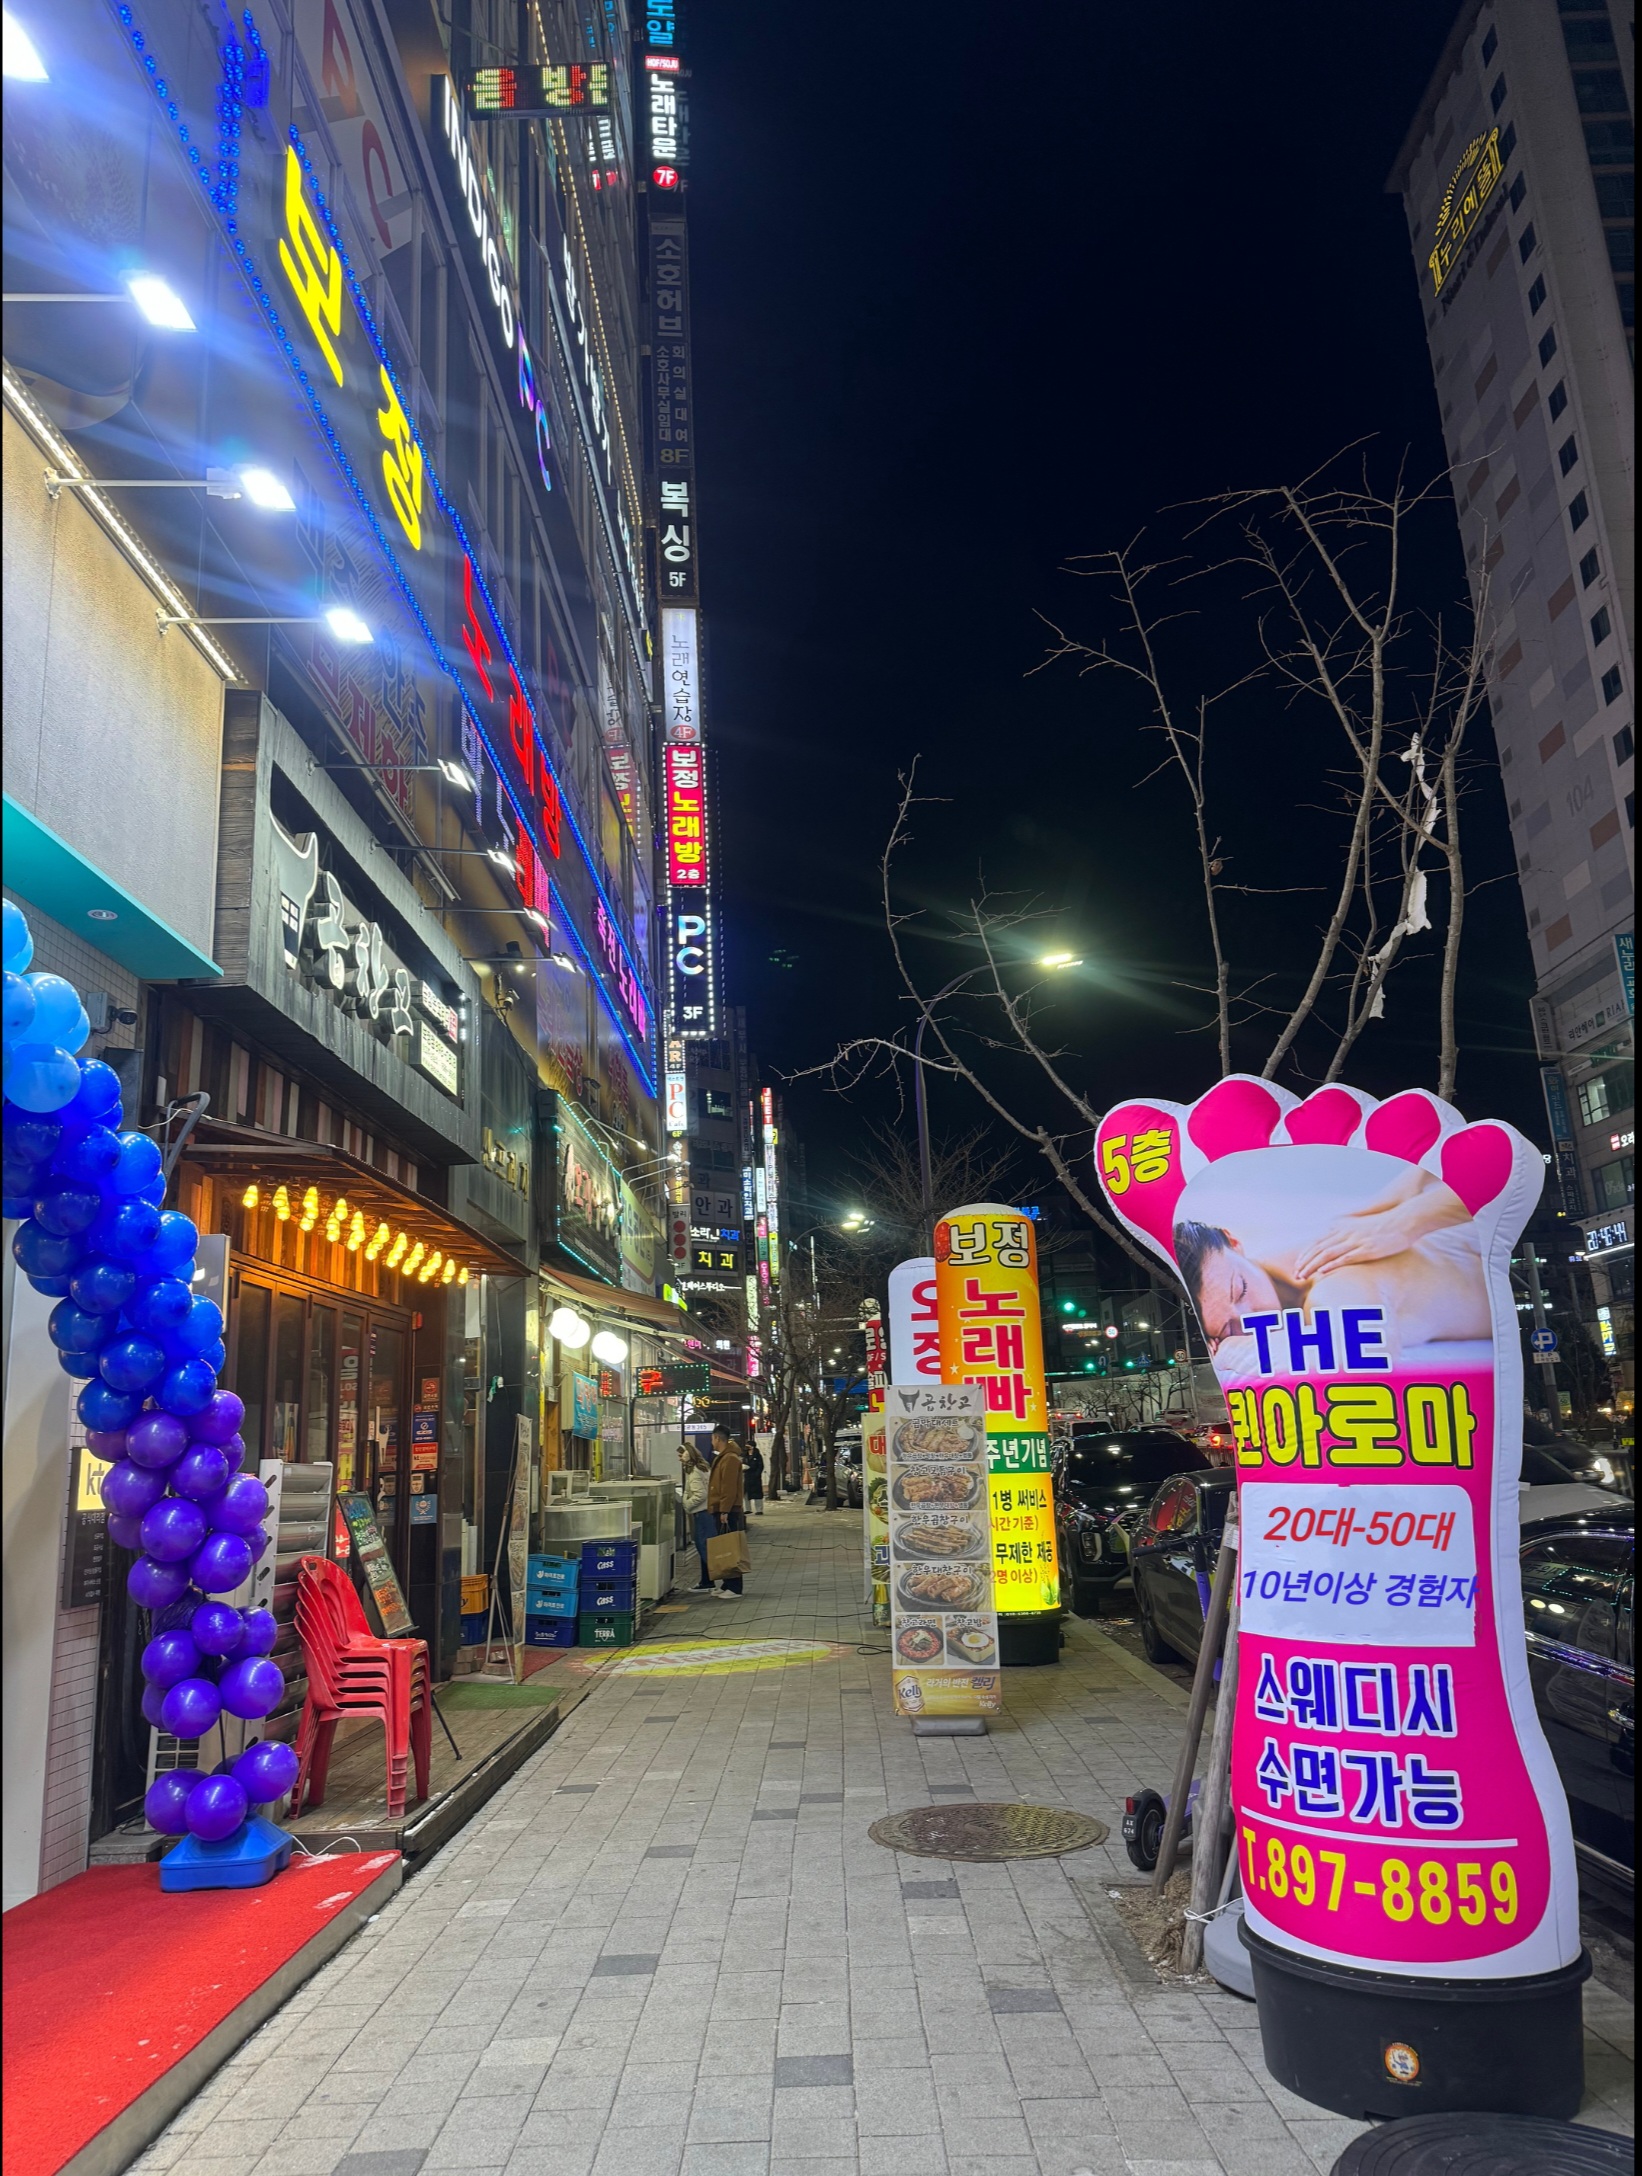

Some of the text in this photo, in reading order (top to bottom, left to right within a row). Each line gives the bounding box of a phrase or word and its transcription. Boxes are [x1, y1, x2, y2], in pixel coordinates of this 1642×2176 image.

[650, 73, 677, 159] 노래타운
[656, 170, 676, 184] 7F
[443, 73, 514, 349] INDIGO
[656, 238, 683, 337] 소호허브
[279, 145, 425, 550] 보정
[660, 449, 689, 463] 8F
[660, 481, 690, 562] 복싱
[668, 572, 687, 587] 5F
[671, 634, 692, 723] 노래연습장
[674, 727, 692, 738] 4F
[672, 749, 703, 865] 보정 노래방
[1566, 774, 1594, 818] 104
[676, 868, 700, 880] 2층
[676, 915, 706, 975] PC
[682, 1006, 703, 1020] 3F
[668, 1083, 684, 1119] PC
[1102, 1128, 1173, 1195] 5층
[694, 1196, 733, 1219] 안과
[949, 1222, 1030, 1269] 보정
[698, 1250, 734, 1269] 치과
[960, 1277, 1033, 1420] 노래빠
[1241, 1307, 1392, 1375] THE
[1176, 1352, 1186, 1361] 50
[921, 1393, 972, 1412] 곱창고
[992, 1489, 1048, 1511] 1병 써비스
[911, 1514, 969, 1526] 한우곱창구이
[1263, 1506, 1456, 1551] 20대-50대
[596, 1560, 614, 1570] Cass
[995, 1541, 1033, 1565] 무제한
[912, 1564, 972, 1576] 한우대창구이
[596, 1596, 614, 1606] Cass
[1242, 1570, 1480, 1608] 10년이상 경험자
[594, 1628, 615, 1638] TERRA
[956, 1617, 982, 1628] 창고밥
[898, 1685, 922, 1699] Kelly
[971, 1676, 995, 1690] 켈리
[1255, 1655, 1457, 1736] 스웨디시
[1256, 1738, 1463, 1829] 수면가능
[1242, 1825, 1519, 1925] T.897-8859
